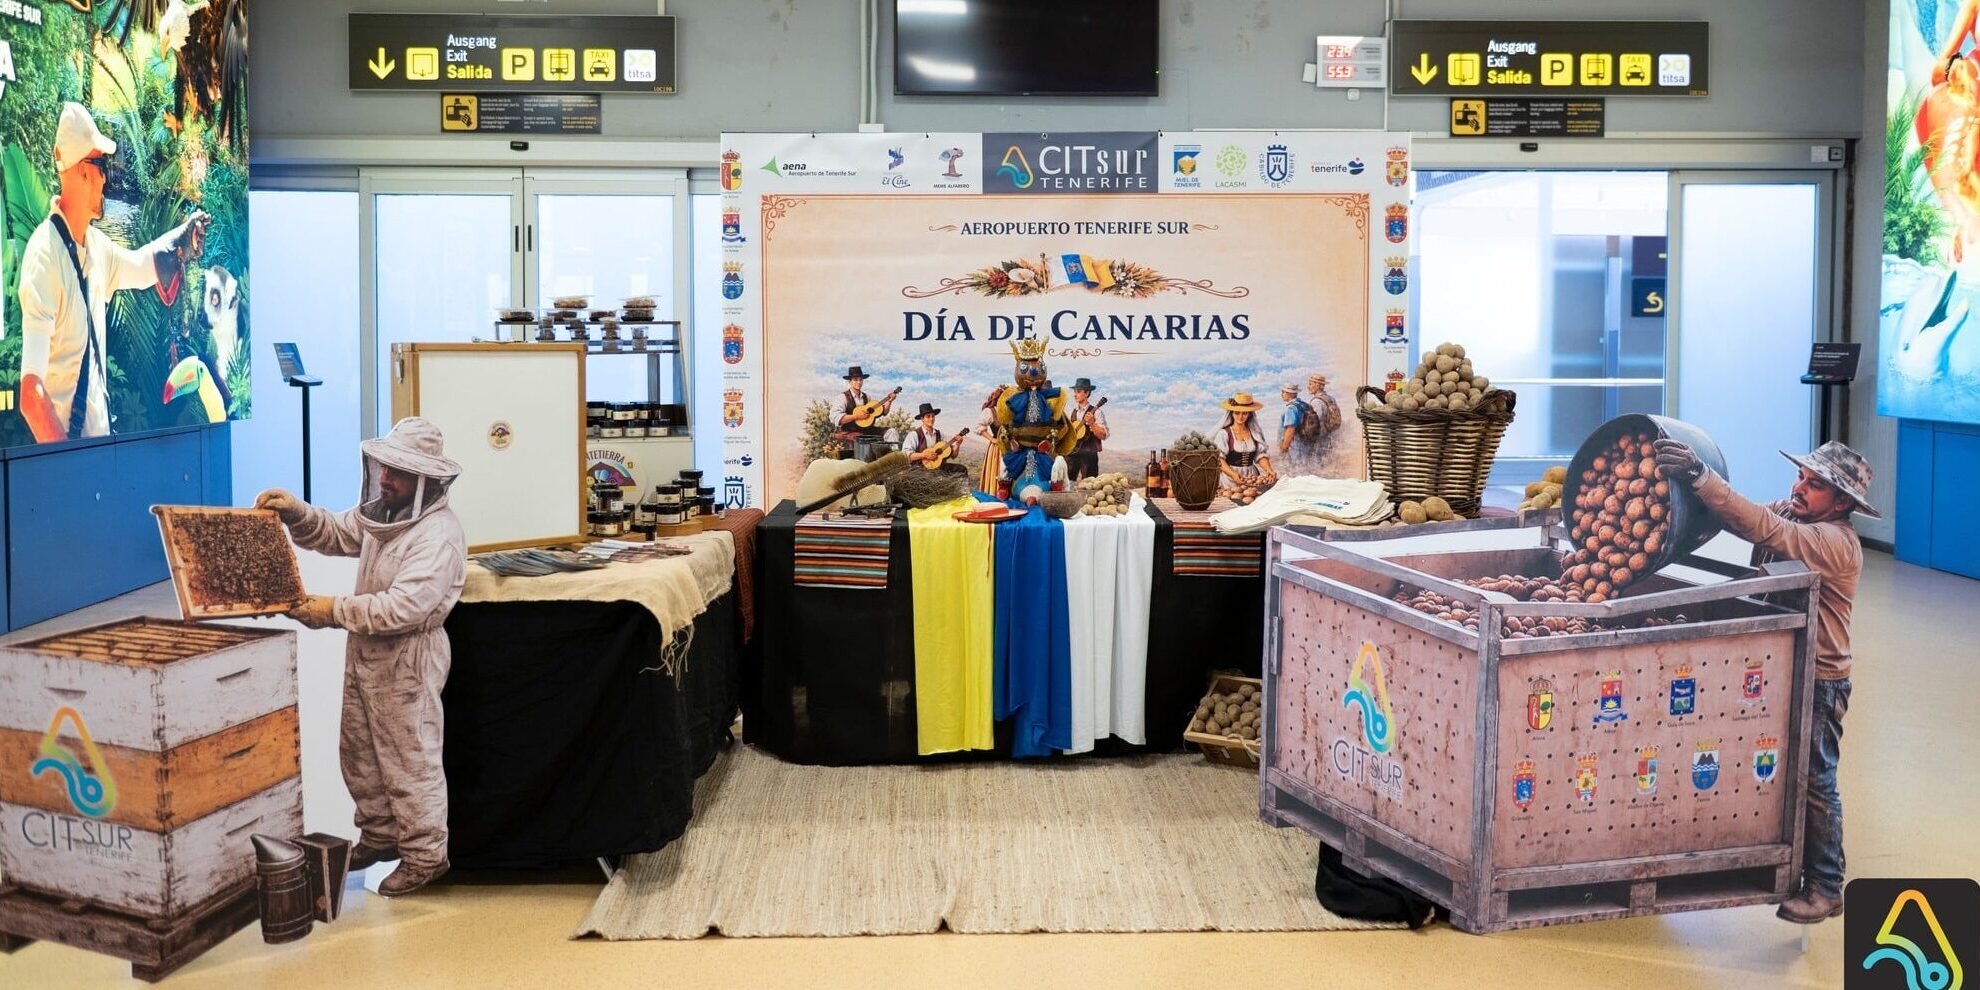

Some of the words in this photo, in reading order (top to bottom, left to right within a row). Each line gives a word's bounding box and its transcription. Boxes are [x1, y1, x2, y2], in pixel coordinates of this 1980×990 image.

[23, 5, 42, 26] SUR
[447, 34, 497, 49] Ausgang
[1487, 40, 1537, 55] Ausgang
[446, 50, 468, 62] Exit
[1486, 55, 1508, 68] Exit
[511, 54, 527, 75] P
[1550, 59, 1565, 80] P
[447, 65, 493, 79] Salida
[628, 69, 652, 79] titsa
[1487, 70, 1532, 84] Salida
[1663, 74, 1685, 83] titsa
[782, 163, 807, 171] aena
[1038, 145, 1148, 175] CITsur
[1311, 164, 1347, 173] tenerife
[1040, 177, 1148, 189] TENERIFE
[960, 221, 1071, 236] AEROPUERTO
[1074, 221, 1153, 235] TENERIFE
[1156, 221, 1190, 235] SUR
[902, 307, 976, 342] DÍA
[987, 315, 1037, 341] DE
[1050, 309, 1251, 341] CANARIAS
